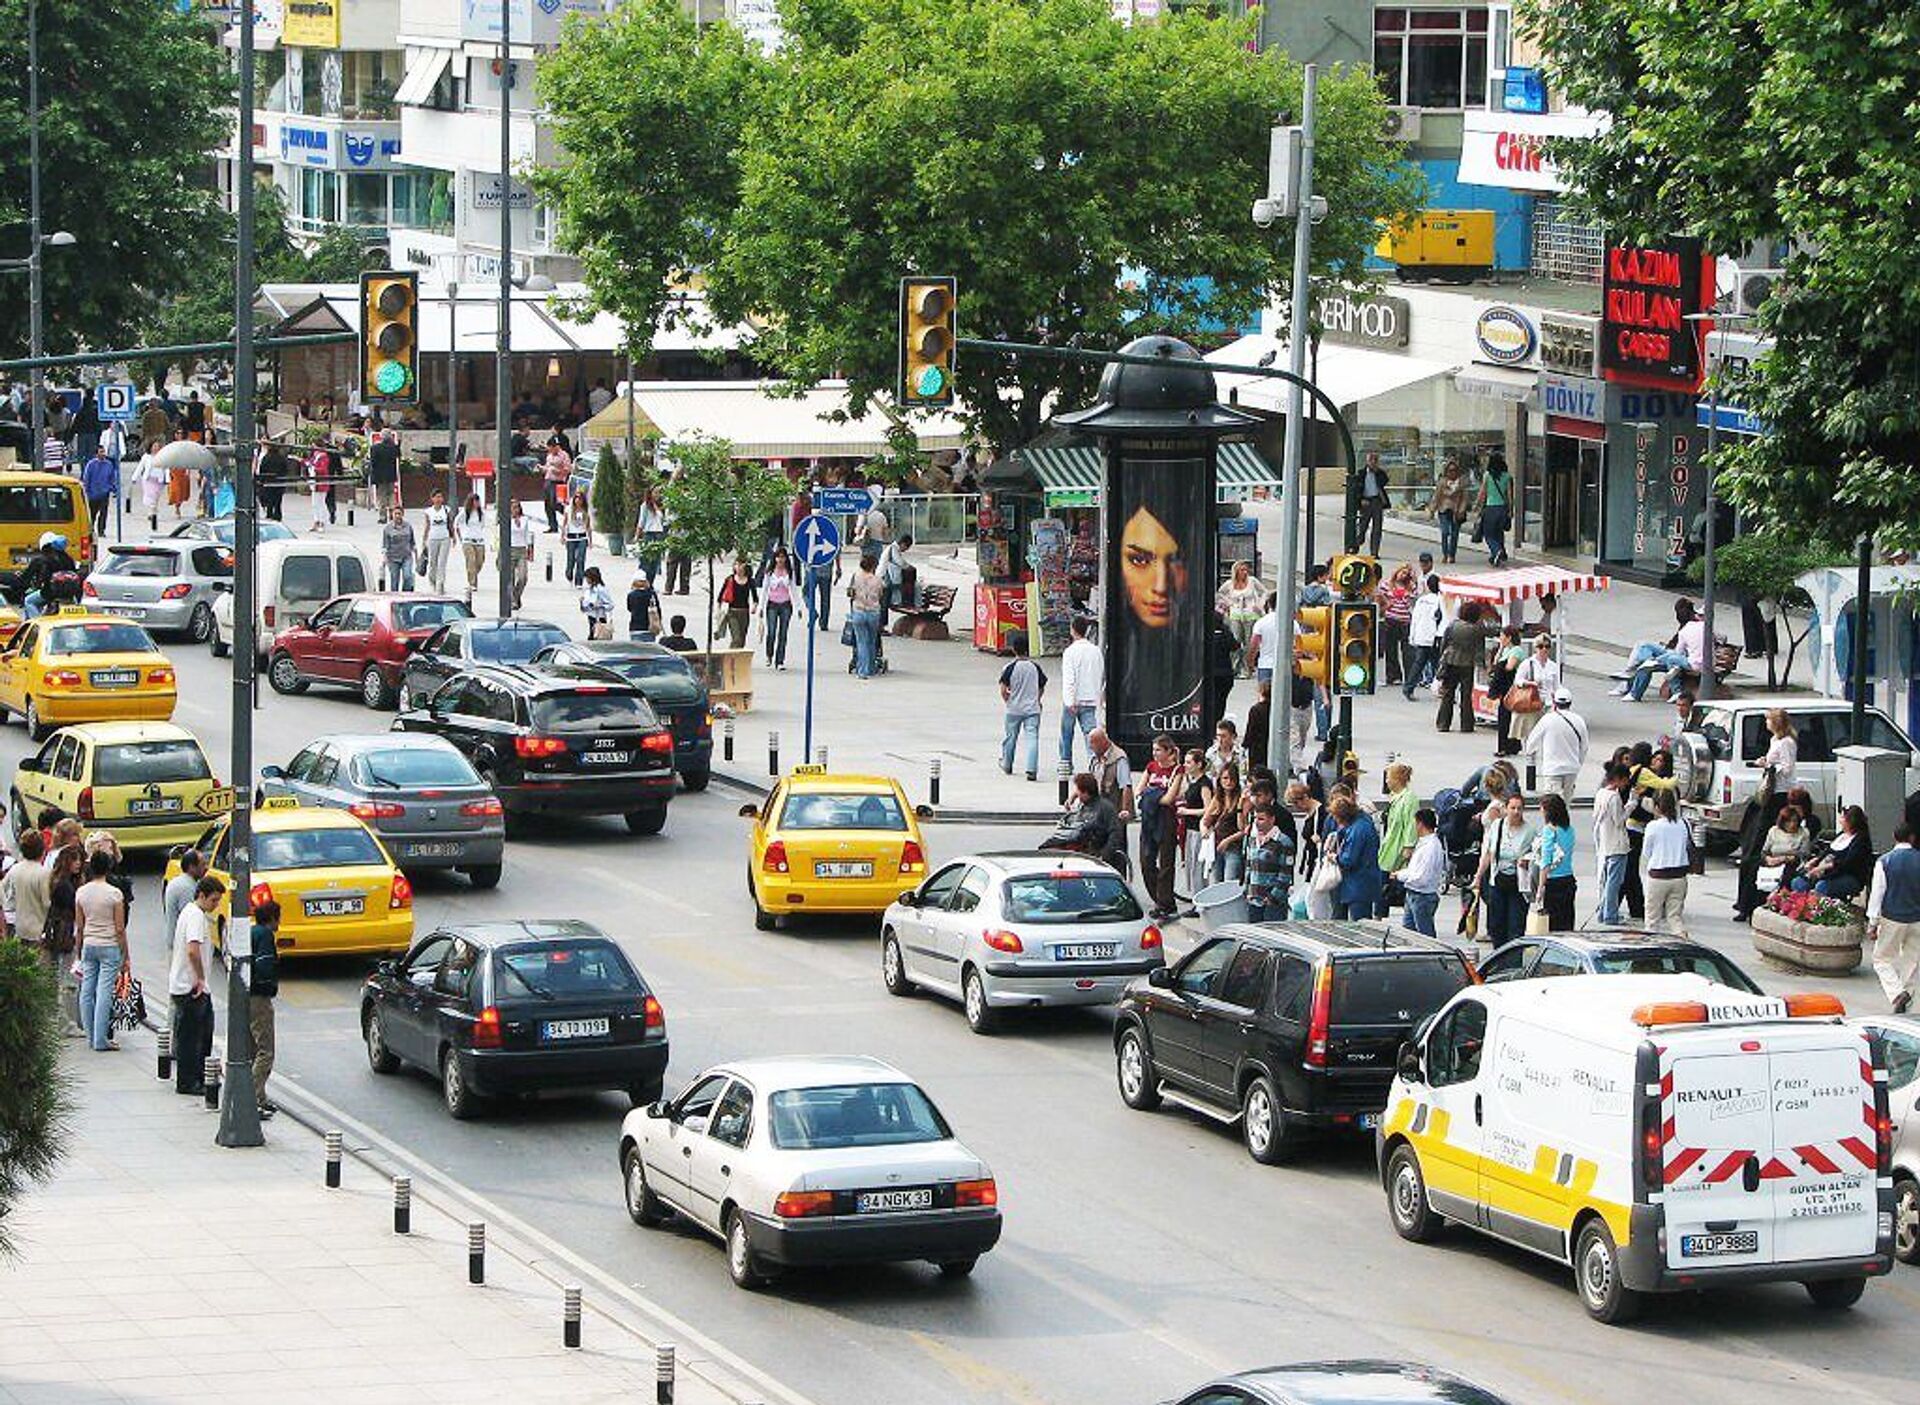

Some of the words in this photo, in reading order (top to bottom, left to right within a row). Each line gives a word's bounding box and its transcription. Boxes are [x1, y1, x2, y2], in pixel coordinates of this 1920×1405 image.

[1608, 290, 1681, 333] KULAN
[108, 389, 124, 409] D
[1342, 564, 1366, 585] 21
[1150, 714, 1200, 732] CLEAR
[206, 793, 231, 809] PTT
[1711, 1004, 1780, 1020] RENAULT
[550, 1024, 563, 1034] 34
[1677, 1087, 1742, 1103] RENAULT
[1827, 1180, 1861, 1192] ALTAN
[864, 1194, 879, 1208] 34
[882, 1193, 912, 1206] NGK
[915, 1191, 931, 1205] 33
[1690, 1238, 1704, 1251] 34
[1706, 1236, 1724, 1250] DP
